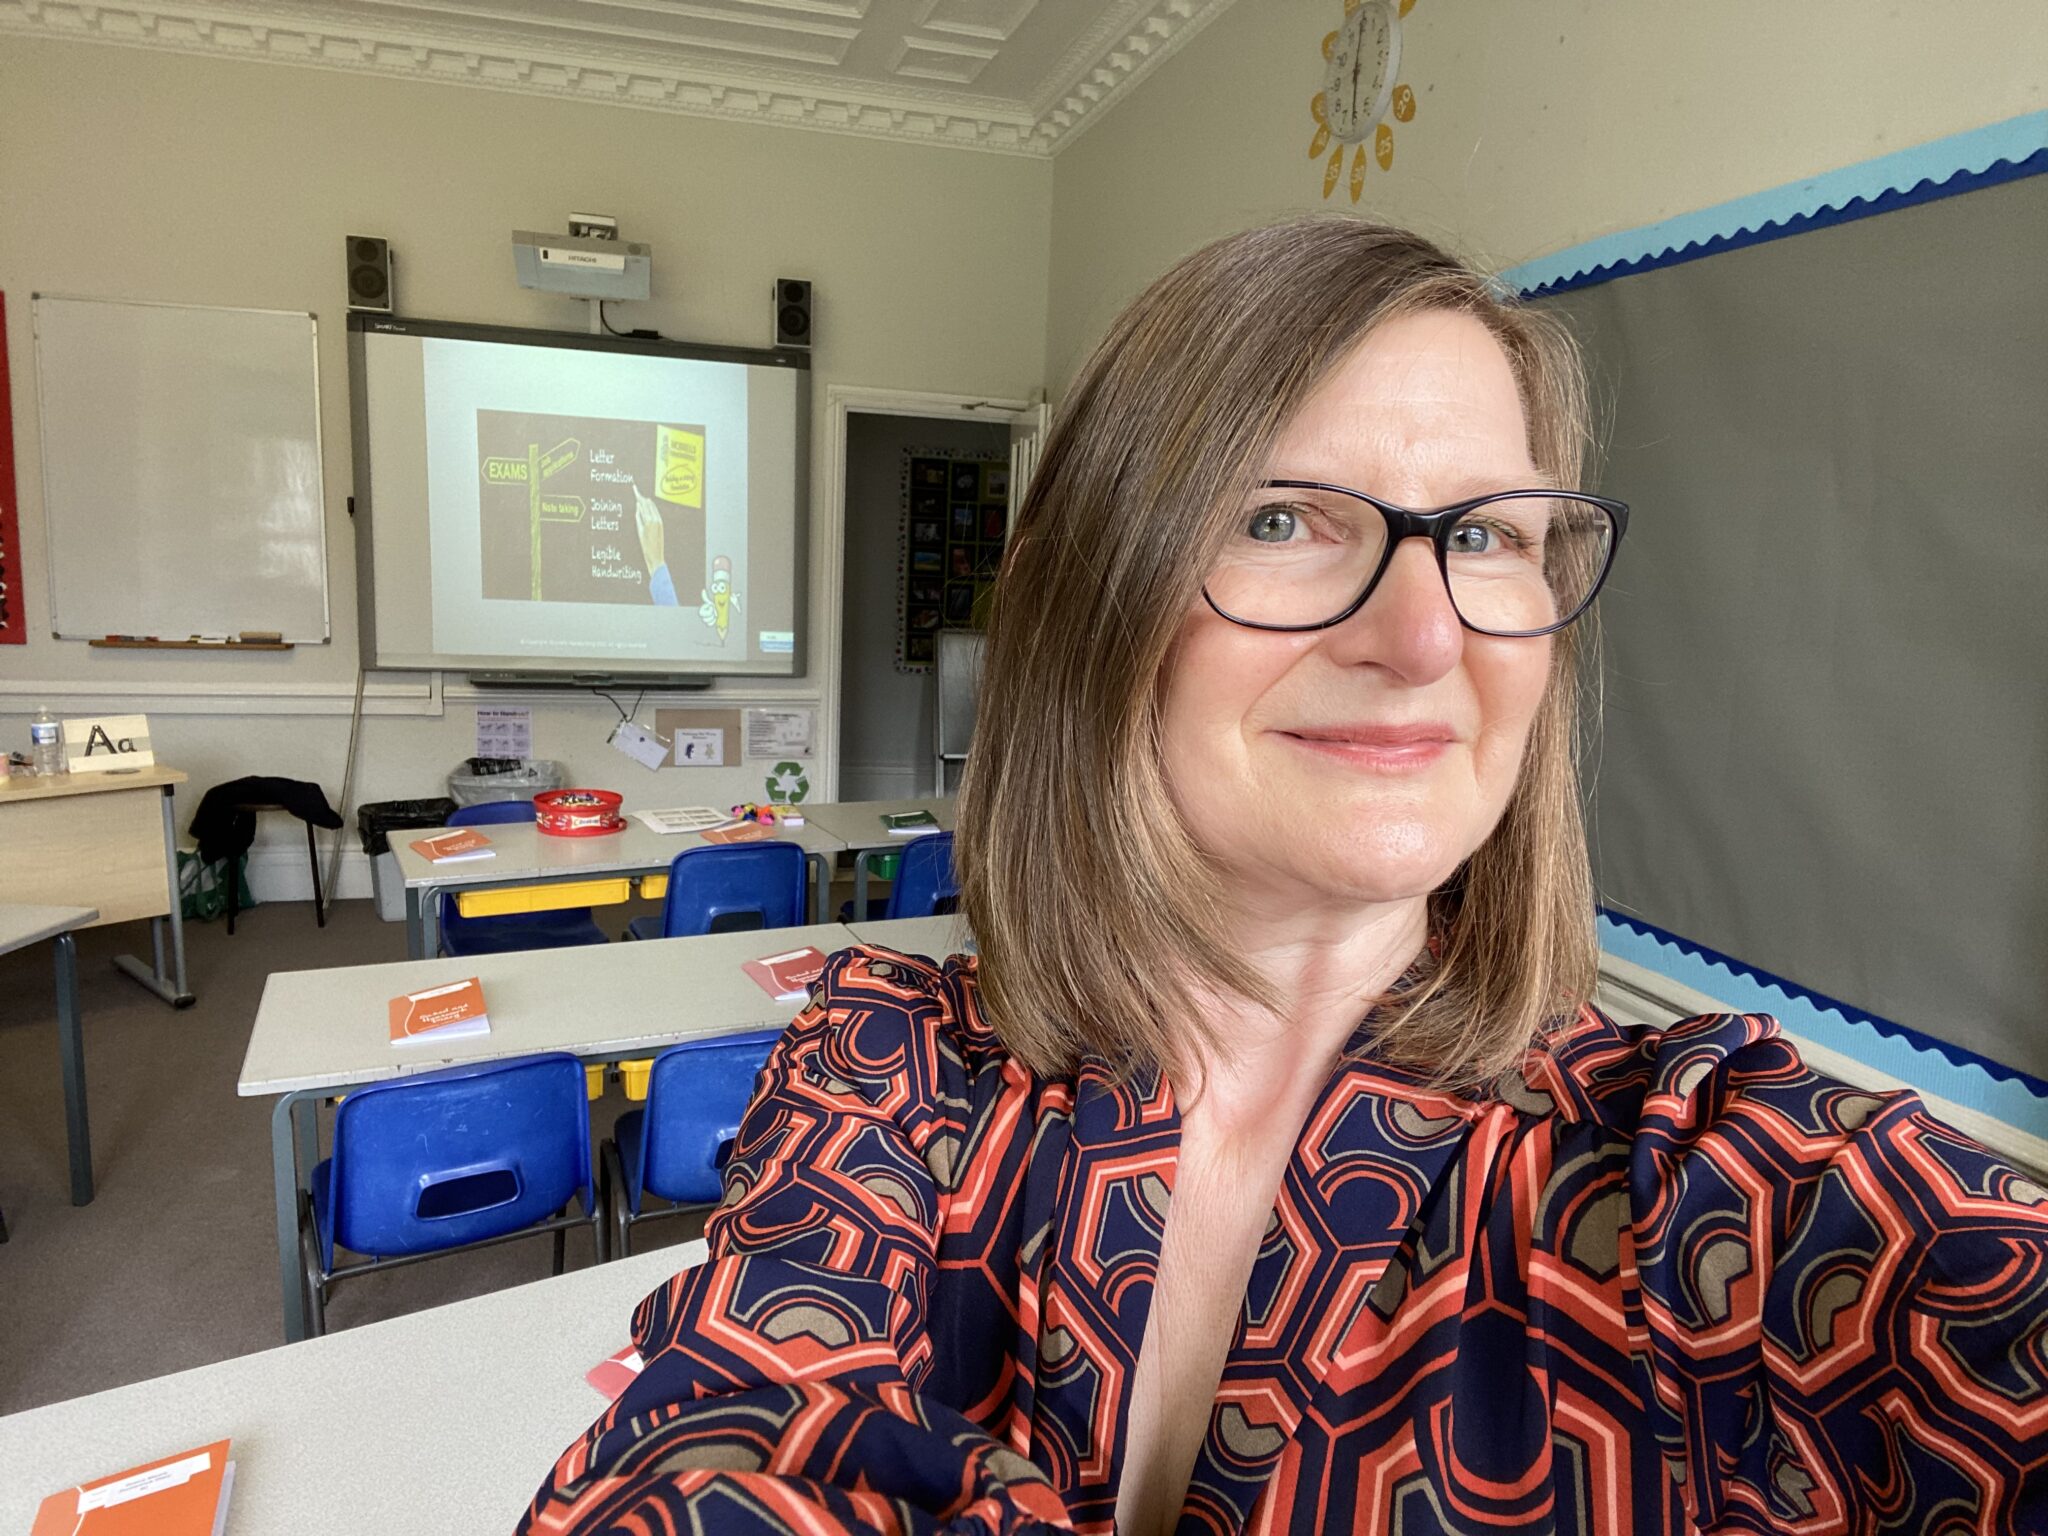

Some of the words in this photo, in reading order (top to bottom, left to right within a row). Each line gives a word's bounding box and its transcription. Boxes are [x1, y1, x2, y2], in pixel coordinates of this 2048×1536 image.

[1396, 87, 1412, 120] 20
[568, 255, 597, 263] HITACHI
[589, 449, 615, 464] Letter
[489, 462, 528, 480] EXAMS
[590, 469, 634, 483] Formation
[591, 498, 623, 517] Joining
[591, 516, 619, 531] Letters
[591, 545, 621, 564] Legible
[591, 564, 642, 584] Handwriting
[83, 723, 138, 757] Aa
